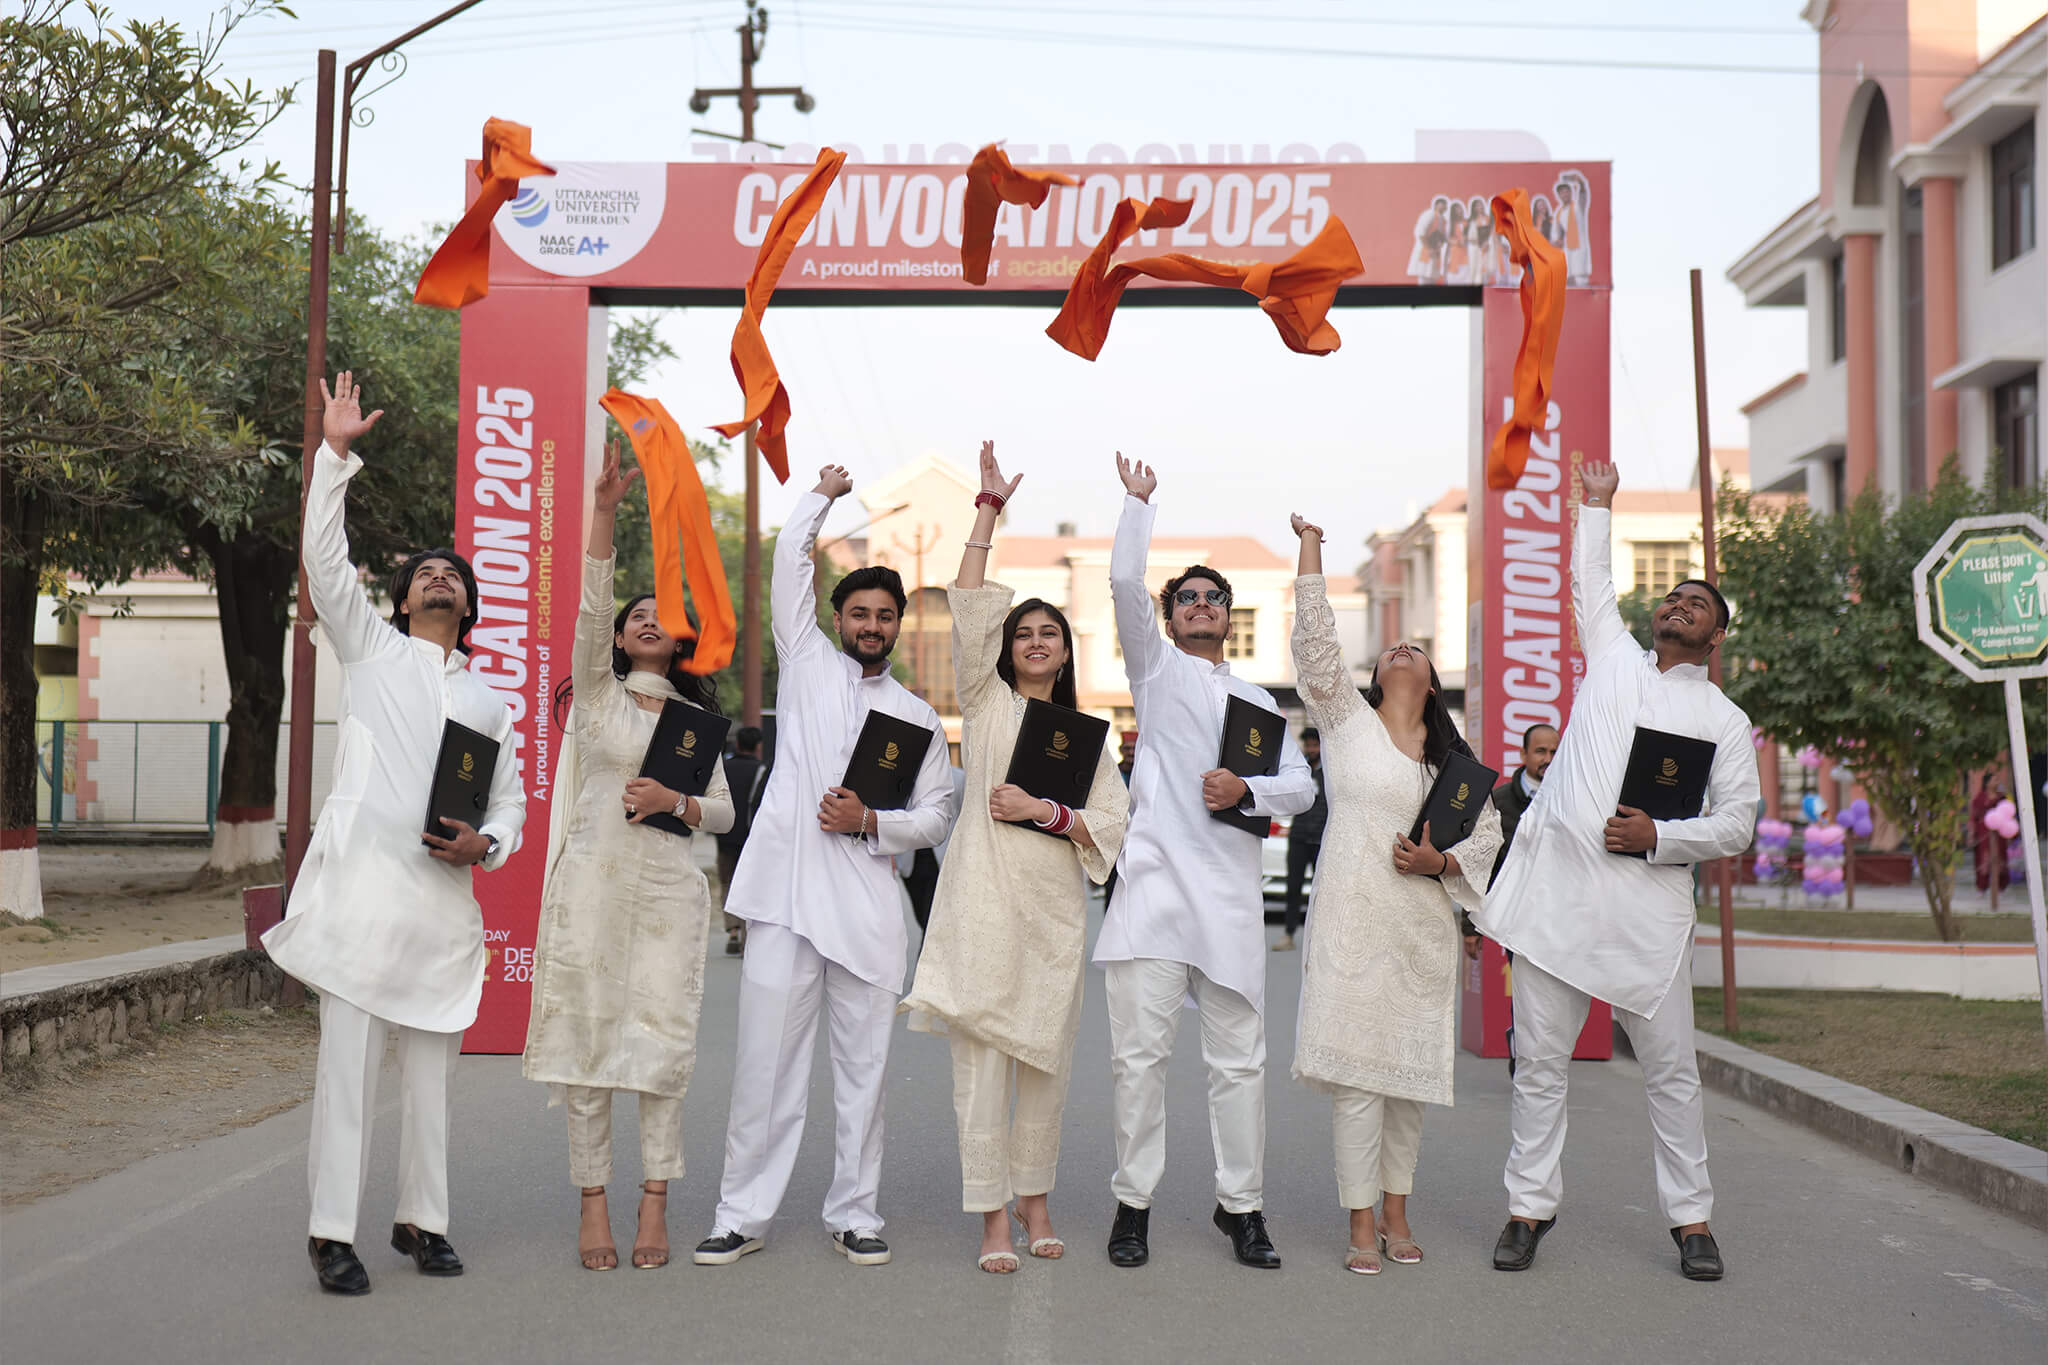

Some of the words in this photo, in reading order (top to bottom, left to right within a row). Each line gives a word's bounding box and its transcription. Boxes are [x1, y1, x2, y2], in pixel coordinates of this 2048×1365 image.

[555, 189, 640, 200] UTTARANCHAL
[555, 200, 640, 213] UNIVERSITY
[1172, 172, 1331, 247] 2025
[566, 214, 630, 225] DEHRADUN
[540, 235, 575, 246] NAAC
[576, 236, 609, 256] A+
[540, 246, 575, 255] GRADE
[801, 259, 817, 276] A
[820, 259, 878, 281] proud
[881, 260, 963, 277] mileston
[474, 385, 534, 512] 2025
[537, 439, 556, 542] excellence
[1963, 557, 2000, 572] PLEASE
[2002, 553, 2032, 568] DON'T
[1984, 571, 2014, 585] Litter
[535, 544, 552, 640] academic
[471, 515, 530, 772] CATION
[536, 644, 550, 660] of
[1503, 527, 1561, 779] OCATION
[534, 664, 549, 737] milestone
[533, 752, 550, 785] proud
[533, 788, 546, 800] A
[484, 929, 510, 942] DAY
[504, 947, 536, 965] DE
